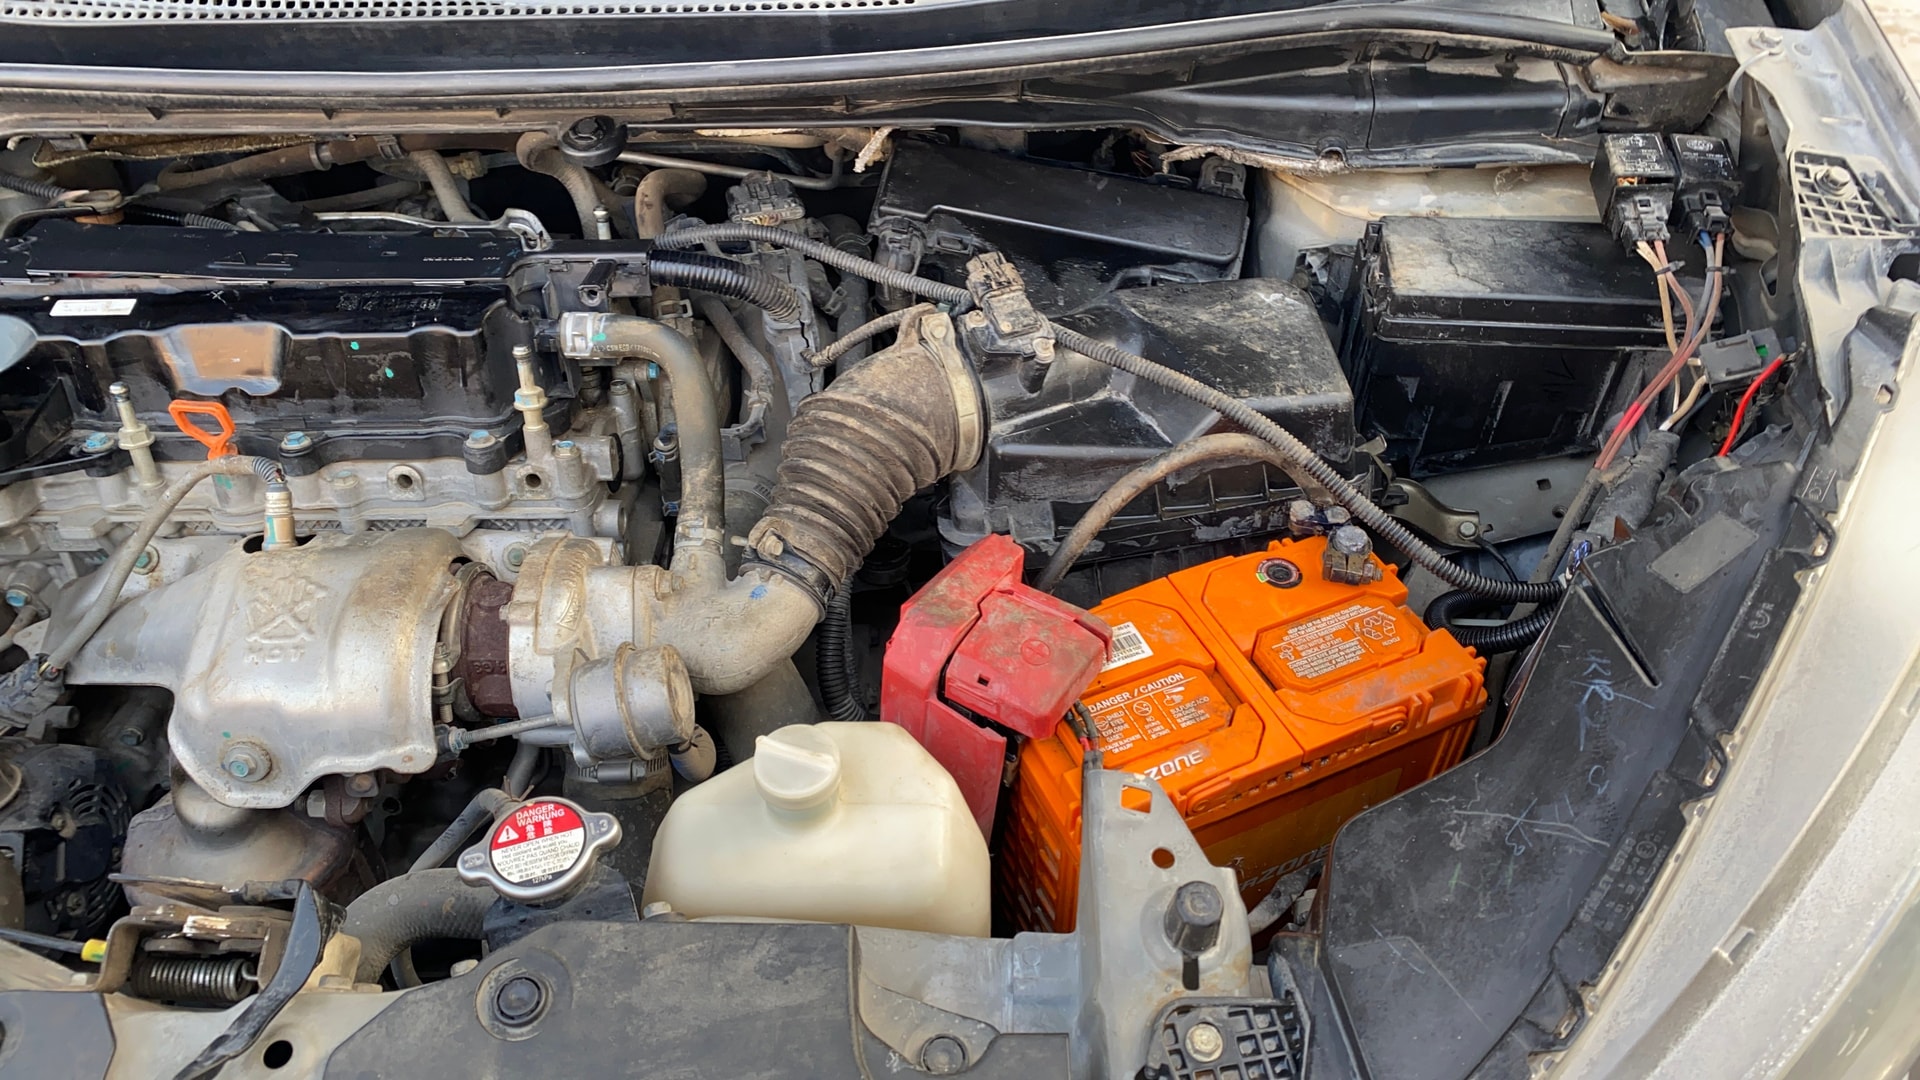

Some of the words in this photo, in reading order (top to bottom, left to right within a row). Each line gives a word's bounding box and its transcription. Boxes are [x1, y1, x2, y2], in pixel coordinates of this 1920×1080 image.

[1089, 693, 1130, 712] DANGER
[1140, 674, 1183, 692] CAUTION
[516, 804, 554, 819] DANGER
[518, 809, 564, 825] WARNUNG
[501, 845, 521, 853] NEVER
[539, 847, 559, 855] QUAND
